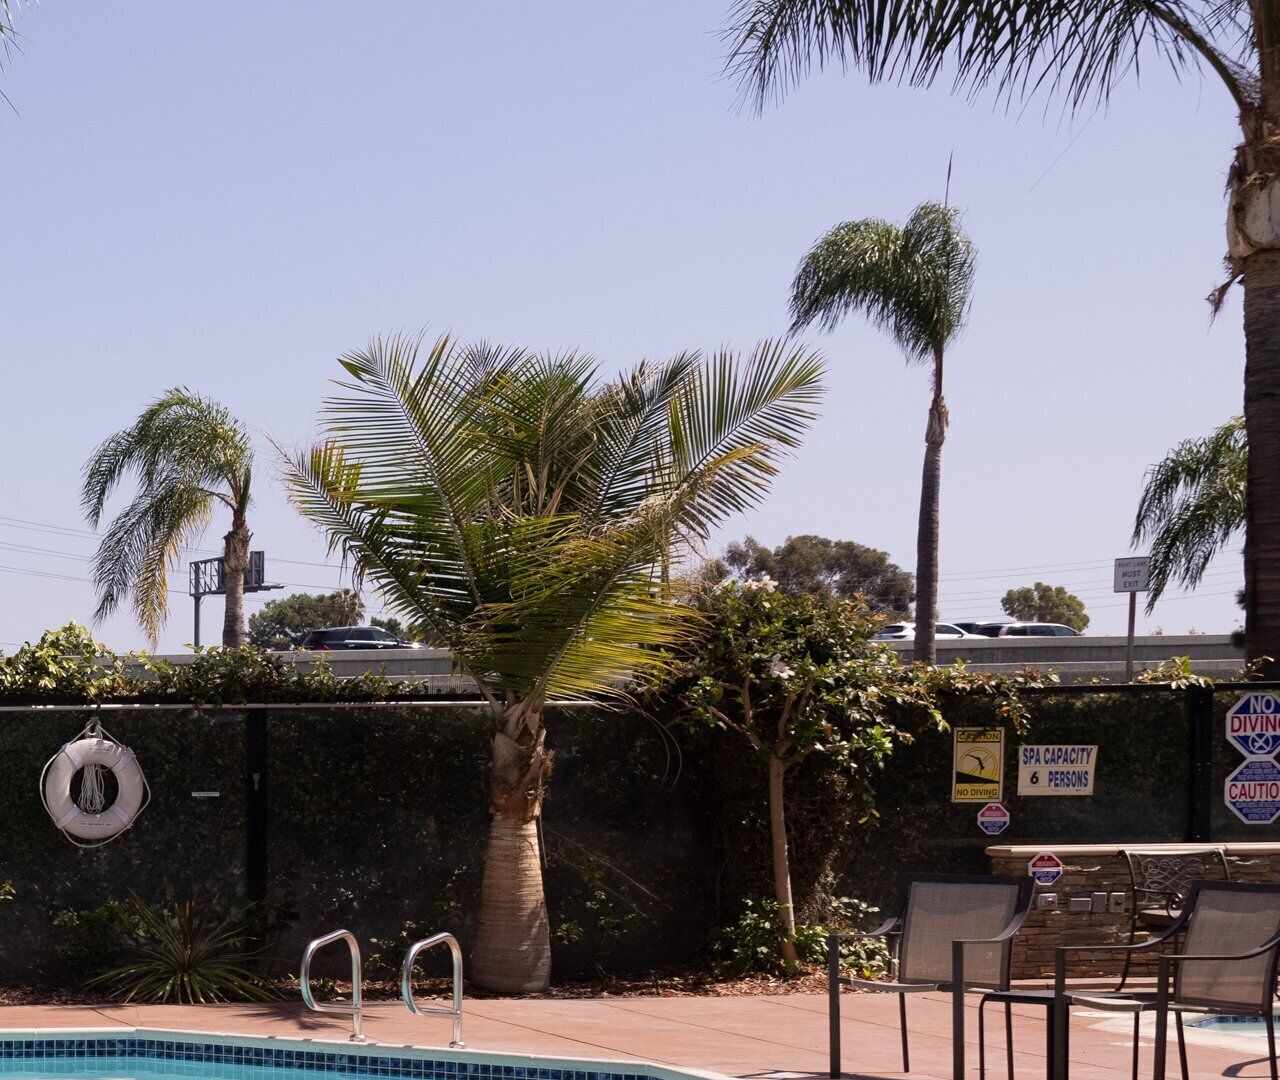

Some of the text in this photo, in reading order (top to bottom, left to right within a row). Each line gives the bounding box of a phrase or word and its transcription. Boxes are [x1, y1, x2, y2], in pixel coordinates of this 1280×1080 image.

[1250, 696, 1274, 714] NO
[1231, 715, 1280, 733] DIVIN
[1023, 747, 1093, 765] SPA CAPACITY
[1030, 771, 1088, 788] 6 PERSONS
[1229, 783, 1280, 799] CAUTIO
